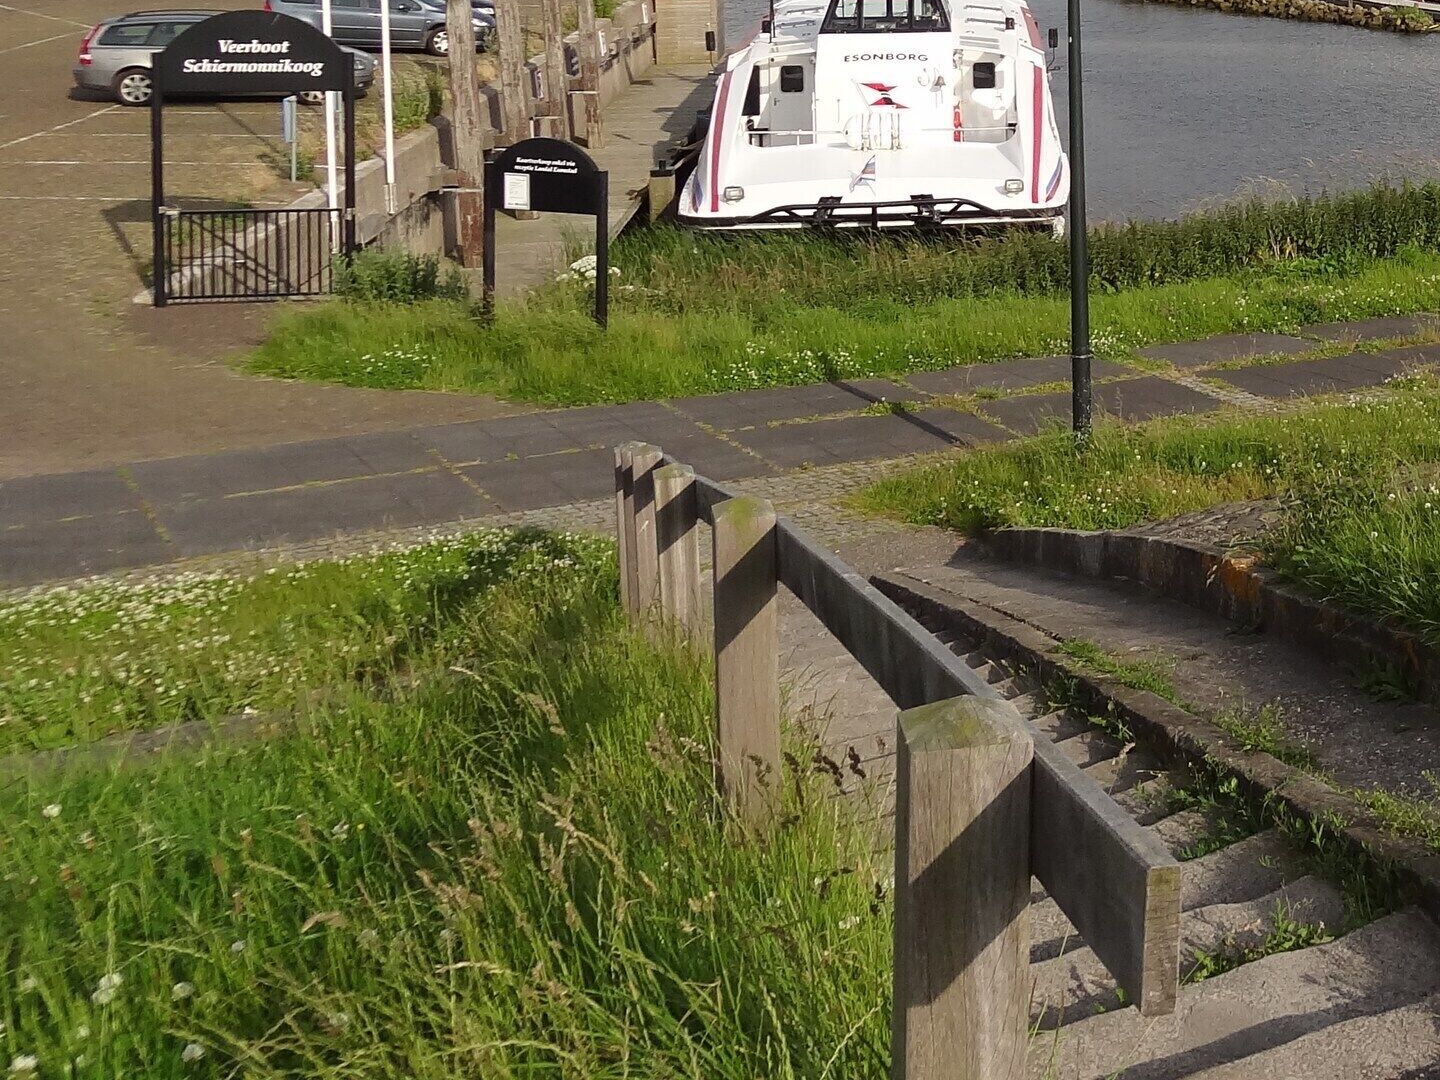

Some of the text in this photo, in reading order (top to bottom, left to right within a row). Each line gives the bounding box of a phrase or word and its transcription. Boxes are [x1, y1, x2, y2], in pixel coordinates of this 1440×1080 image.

[218, 39, 291, 54] Veerboot
[844, 53, 928, 62] ESONBORG
[183, 58, 324, 76] Schiermonnikoog
